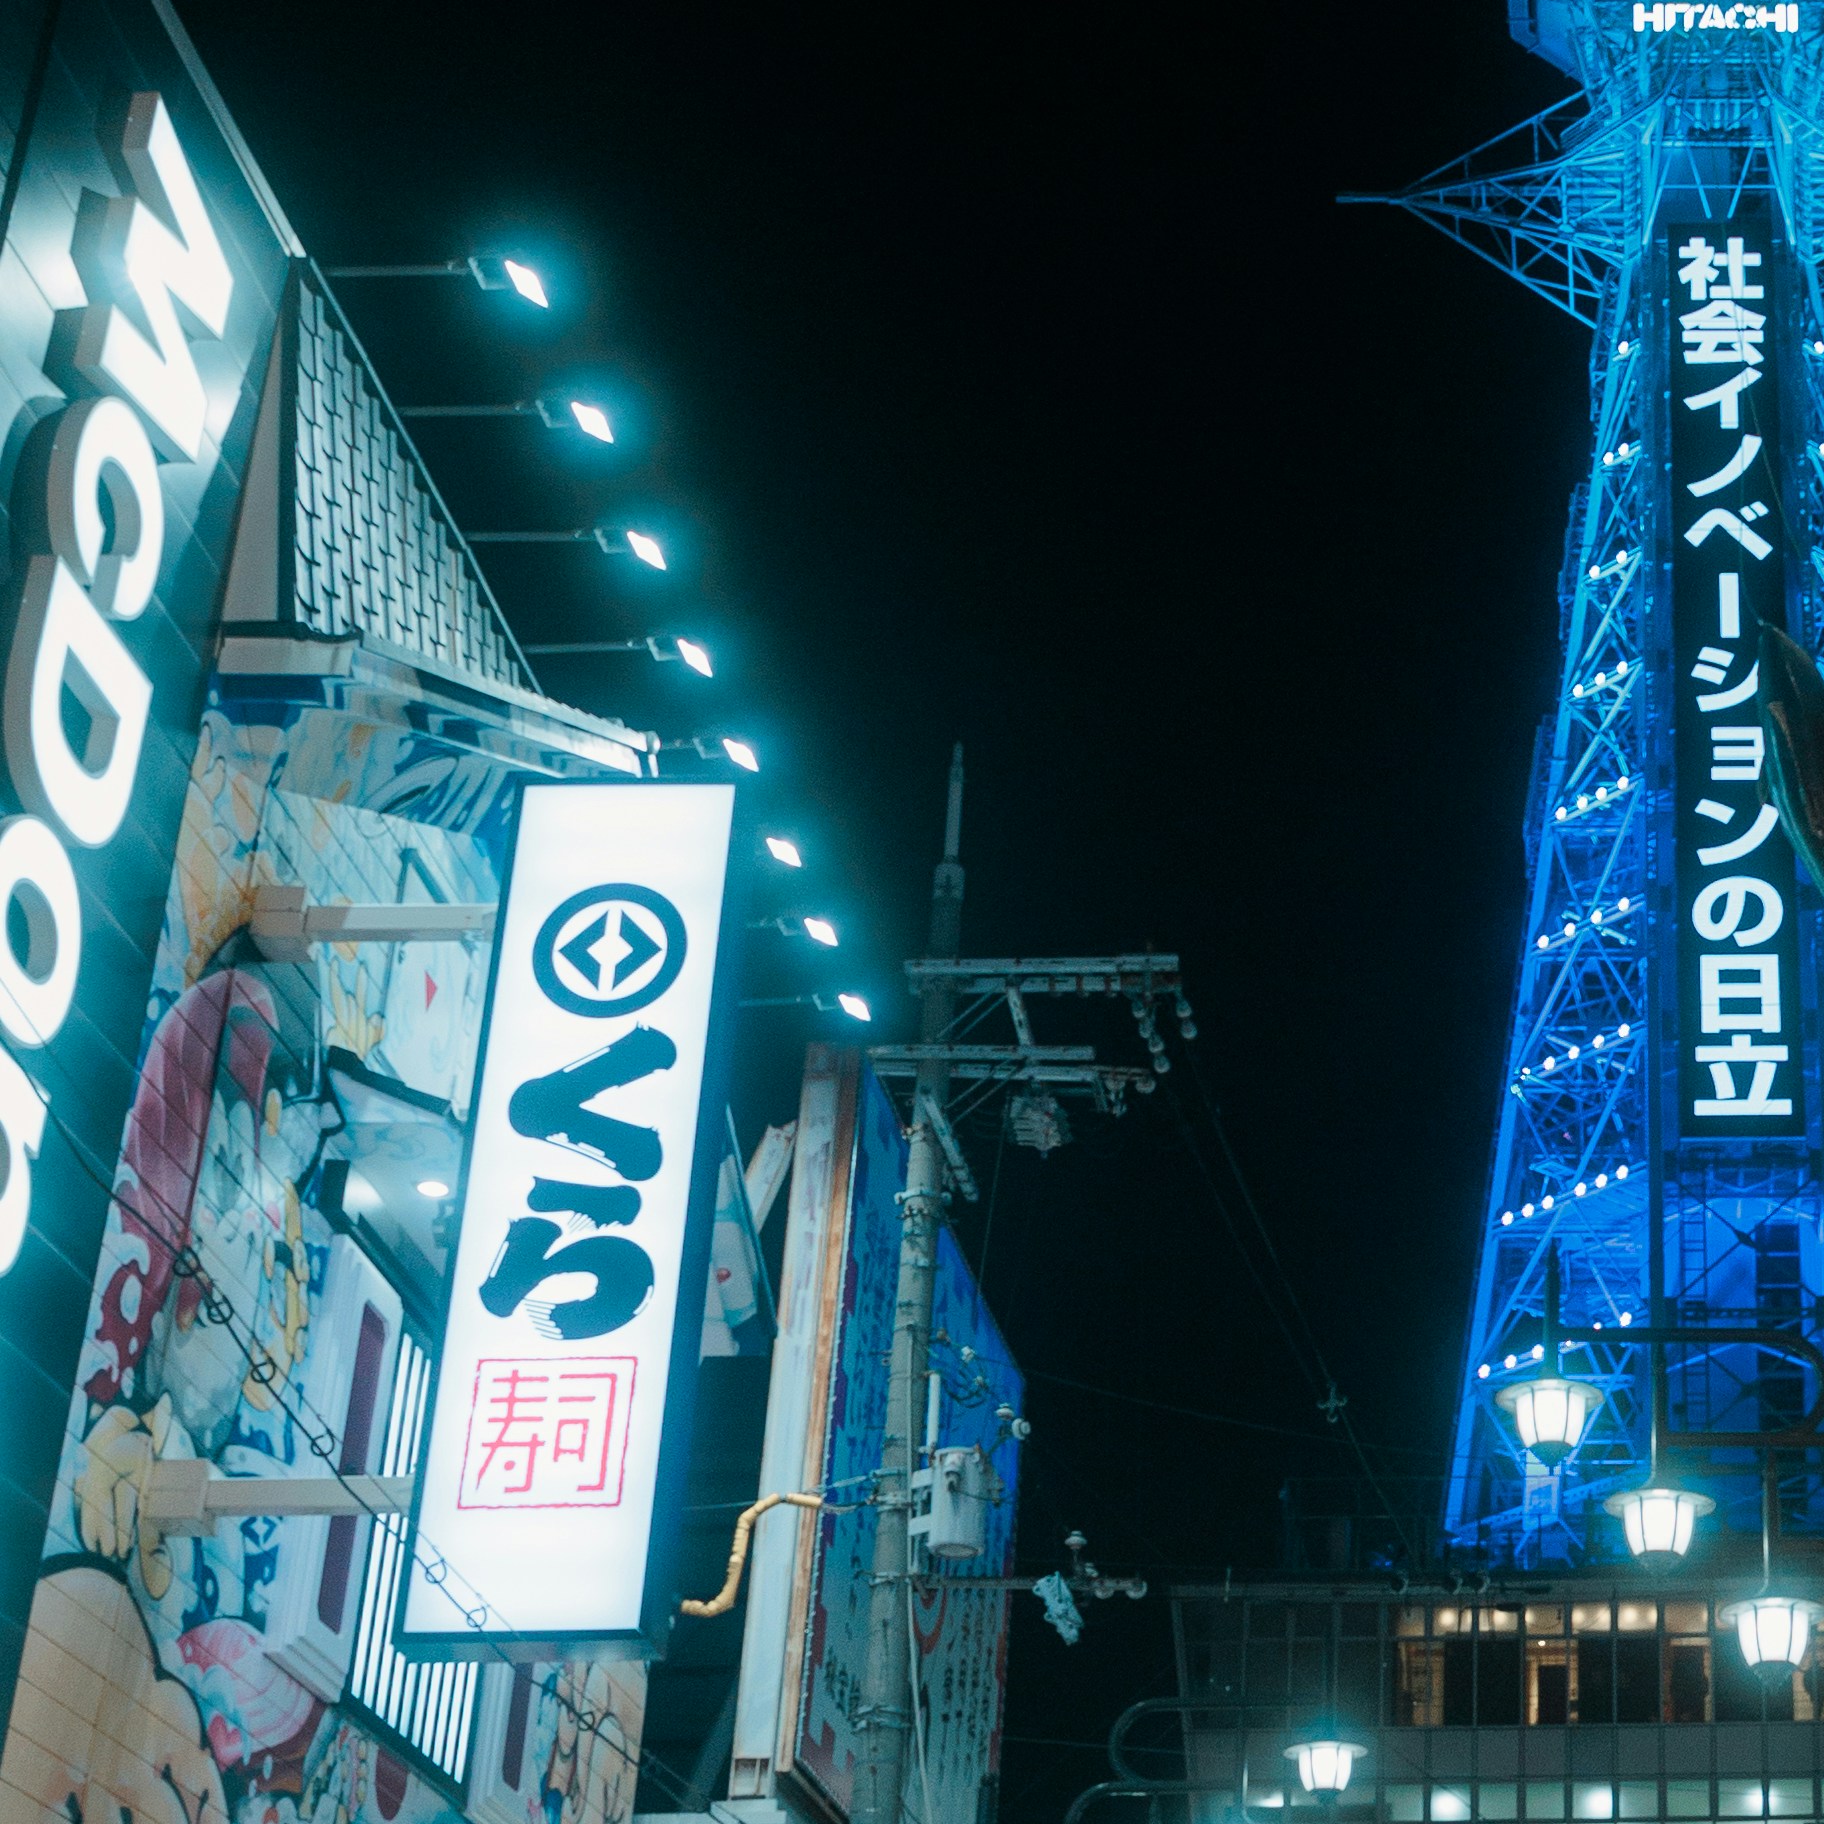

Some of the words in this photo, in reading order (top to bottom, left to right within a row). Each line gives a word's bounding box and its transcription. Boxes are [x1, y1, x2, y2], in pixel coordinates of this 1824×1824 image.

[1632, 3, 1799, 33] HITACHI
[1678, 236, 1794, 1117] 社会イノベーションの日立
[479, 1022, 677, 1340] くら
[476, 1369, 618, 1494] 寿司
